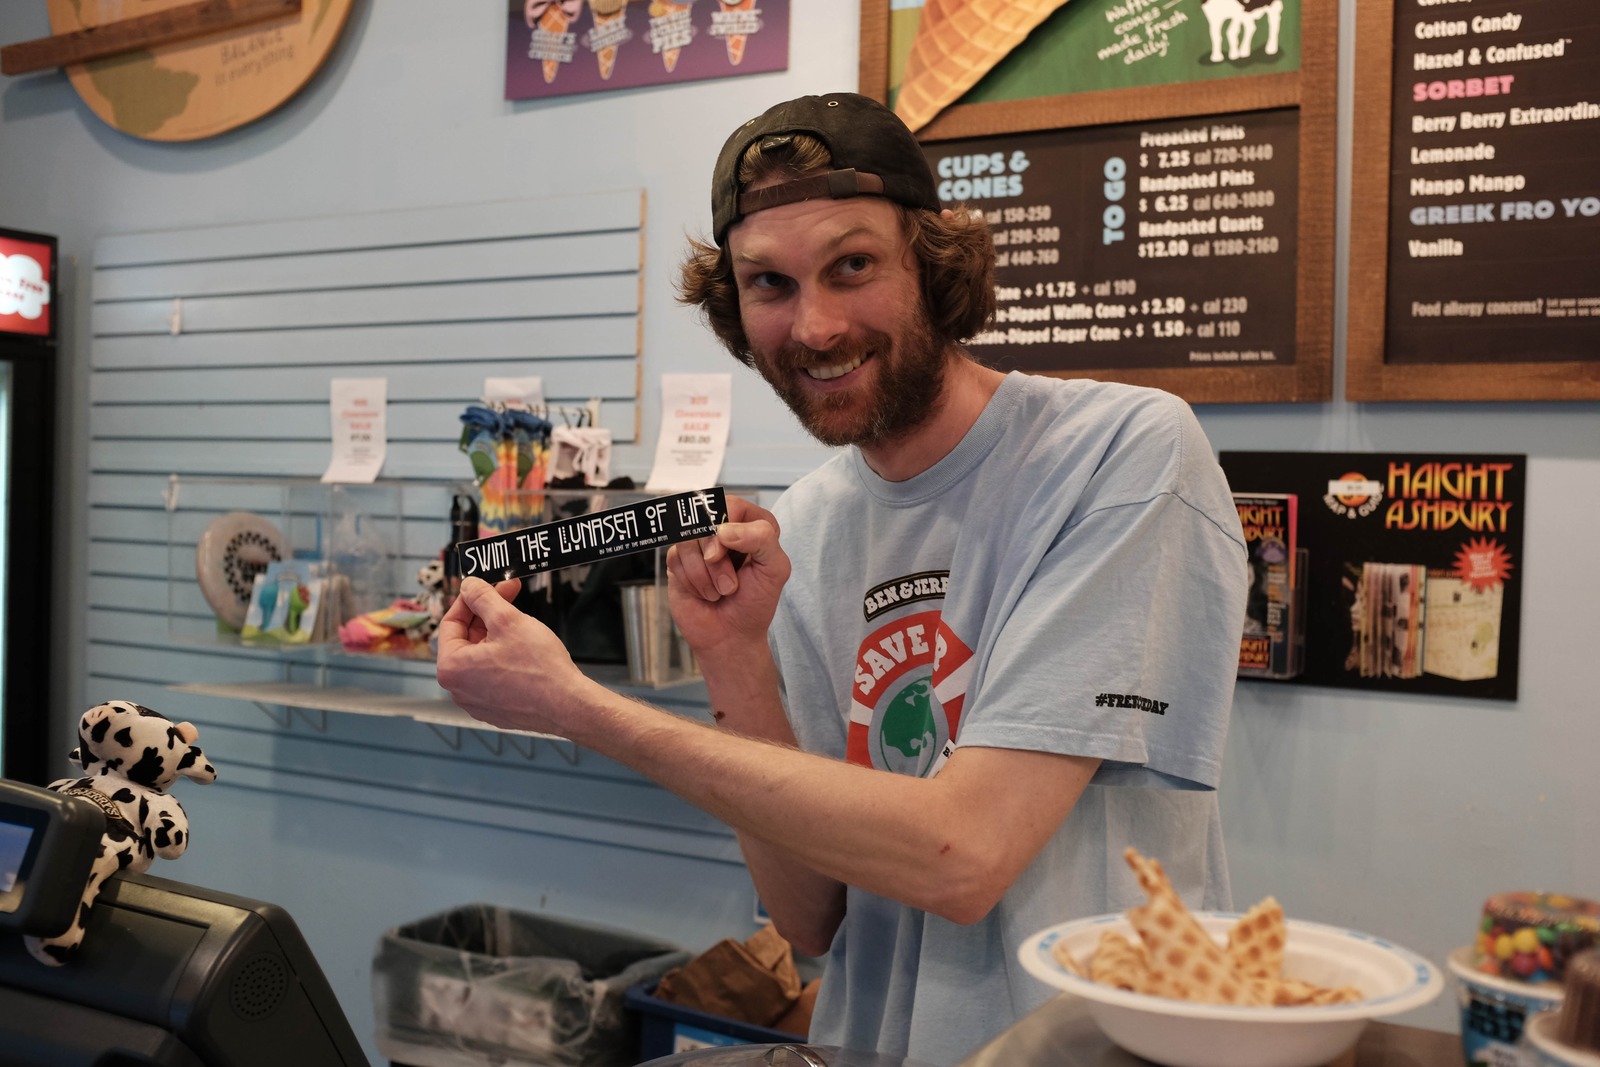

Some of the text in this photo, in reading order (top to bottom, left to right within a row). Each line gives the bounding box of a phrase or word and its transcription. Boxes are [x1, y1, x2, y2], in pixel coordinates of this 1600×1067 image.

[1114, 7, 1161, 35] cones
[1414, 12, 1522, 39] Cotton Candy
[1097, 10, 1188, 60] made fresh
[1413, 49, 1464, 71] Hazed
[1468, 47, 1482, 65] &
[1412, 74, 1515, 102] SORBET
[1412, 115, 1457, 133] Berry
[1460, 111, 1507, 130] Berry
[1140, 125, 1246, 148] Prepacked Pints
[937, 150, 1031, 179] CUPS &
[1193, 149, 1212, 166] cal
[1410, 142, 1495, 164] Lemonade
[937, 174, 1024, 202] CONES
[1139, 169, 1255, 193] Handpacked Pints
[1410, 174, 1526, 196] Mango Mango
[1102, 156, 1127, 246] TO GO
[1192, 195, 1211, 211] cal
[1212, 190, 1275, 210] 640-1080
[1409, 196, 1600, 226] GREEK FRO YO
[1004, 205, 1052, 223] 150-250
[1138, 215, 1264, 238] Handpacked Quarts
[1138, 236, 1279, 258] $12.00 cal 1280-2160
[1408, 238, 1464, 258] Vanilla
[1093, 280, 1111, 297] cal
[1113, 279, 1137, 296] 190
[1052, 303, 1094, 321] Waffle
[1095, 302, 1126, 319] Cone
[1202, 298, 1221, 315] cal
[1222, 297, 1248, 314] 230
[1411, 297, 1544, 318] Food allergy concerns?
[1052, 325, 1088, 344] Sugar
[1090, 325, 1121, 342] Cone
[1197, 321, 1215, 338] cal
[1217, 320, 1241, 338] 110
[1387, 462, 1513, 500] HAIGHT
[1385, 500, 1513, 533] ASHBURY
[464, 539, 510, 575] SWIM
[516, 530, 551, 563] THE
[645, 502, 667, 534] OF
[676, 493, 718, 527] LIFE
[854, 624, 930, 696] SAVE
